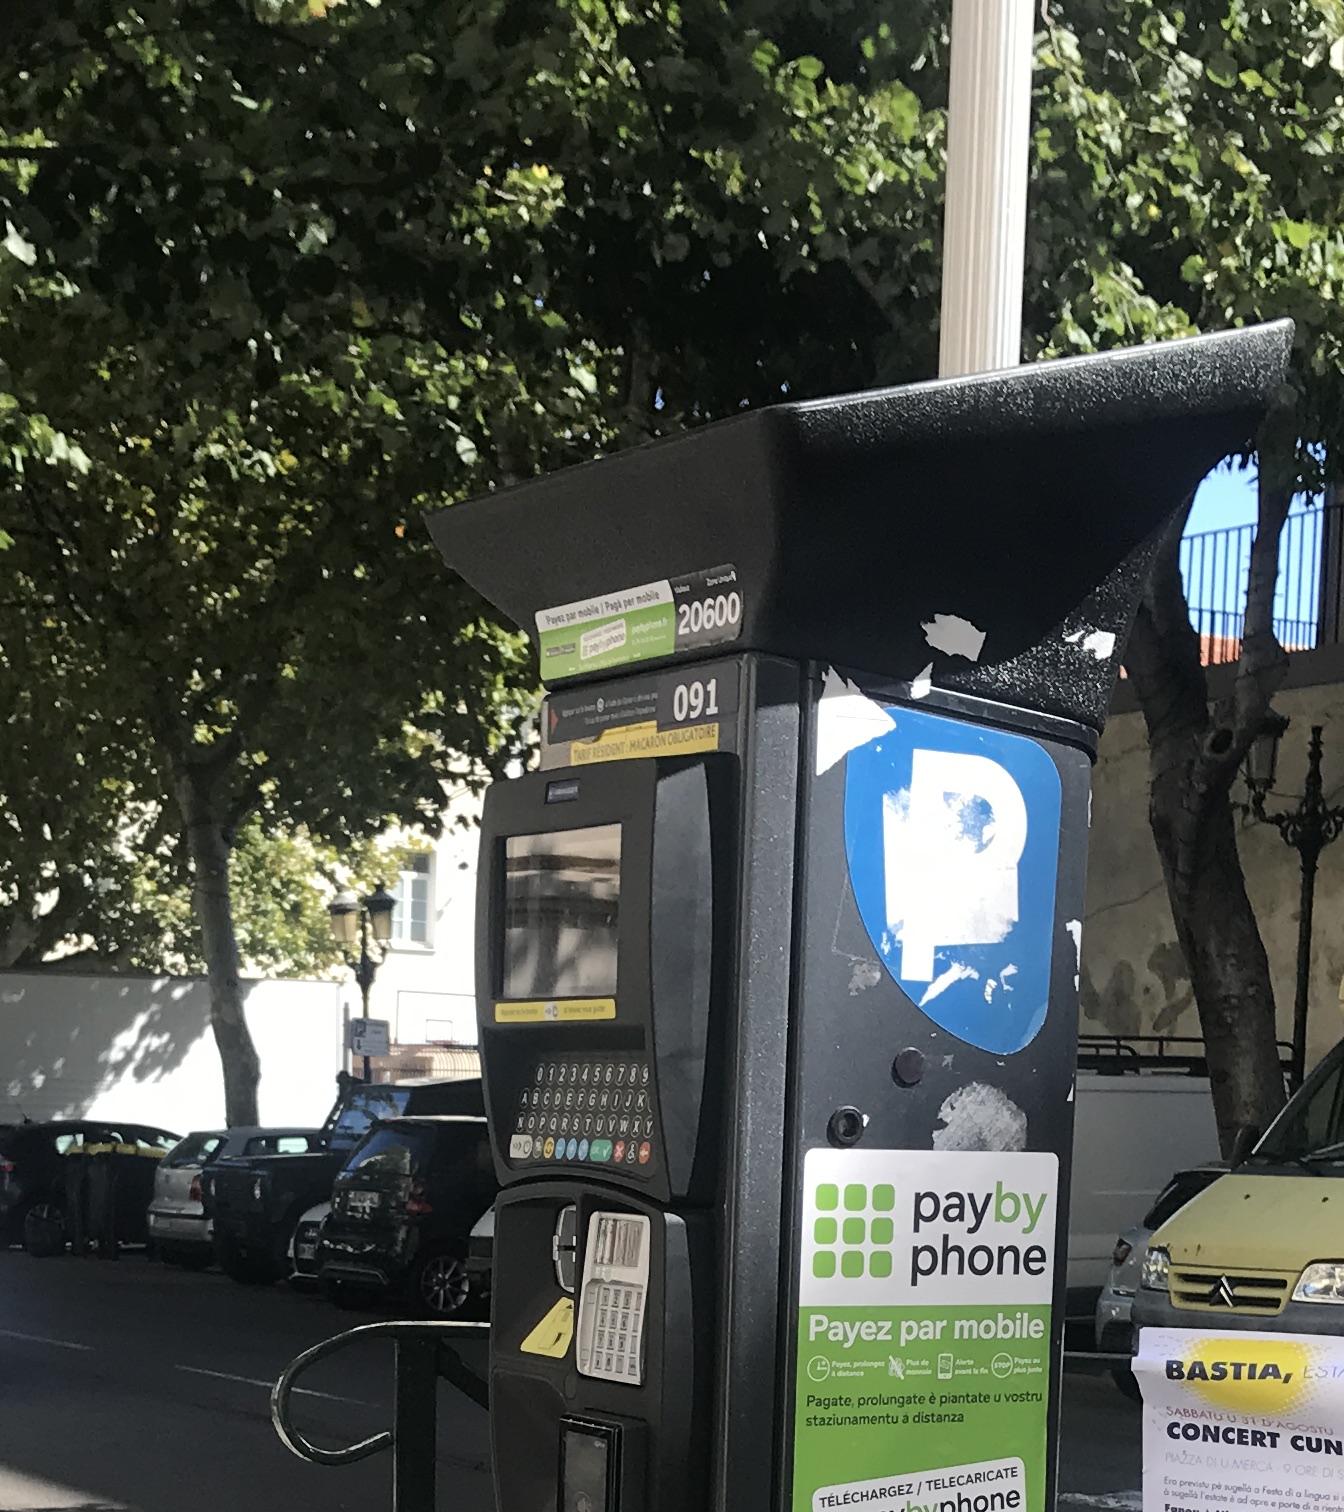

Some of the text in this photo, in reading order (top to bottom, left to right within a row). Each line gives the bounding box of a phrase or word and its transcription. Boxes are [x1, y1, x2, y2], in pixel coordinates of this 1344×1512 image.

[565, 609, 578, 624] par
[624, 597, 636, 610] per
[636, 590, 660, 606] mobile
[678, 591, 741, 636] 20600
[673, 678, 720, 722] 091
[629, 734, 667, 751] MACARON
[667, 725, 716, 746] OBLIGATOIRE
[912, 1180, 1048, 1234] payby
[910, 1233, 1047, 1287] phone
[808, 1312, 1045, 1349] Payez par mobile
[1165, 1359, 1294, 1384] BASTIA,
[805, 1392, 1043, 1411] Pagate, prolungate è piantate u vostru
[805, 1411, 964, 1427] staziunamentu distanza
[1165, 1405, 1224, 1422] SABBATU
[1226, 1411, 1237, 1424] U
[1261, 1416, 1335, 1437] D'AGOSTU
[1166, 1421, 1281, 1449] CONCERT
[1289, 1435, 1344, 1457] CUN
[1164, 1450, 1203, 1467] PIAZZA
[1206, 1455, 1218, 1467] DI
[1220, 1456, 1230, 1469] U
[1293, 1463, 1318, 1477] ORE
[1322, 1466, 1335, 1479] DI
[818, 1466, 1019, 1509] TÉLÉCHARGEZ / TELECARICATE
[1163, 1475, 1178, 1486] Era
[1179, 1477, 1210, 1490] previstu
[1262, 1485, 1283, 1497] Festa
[1285, 1487, 1294, 1498] di
[1304, 1489, 1331, 1503] lingua
[1332, 1493, 1340, 1502] si
[1237, 1494, 1249, 1505] ad
[1278, 1499, 1301, 1511] porte
[1302, 1501, 1311, 1511] di
